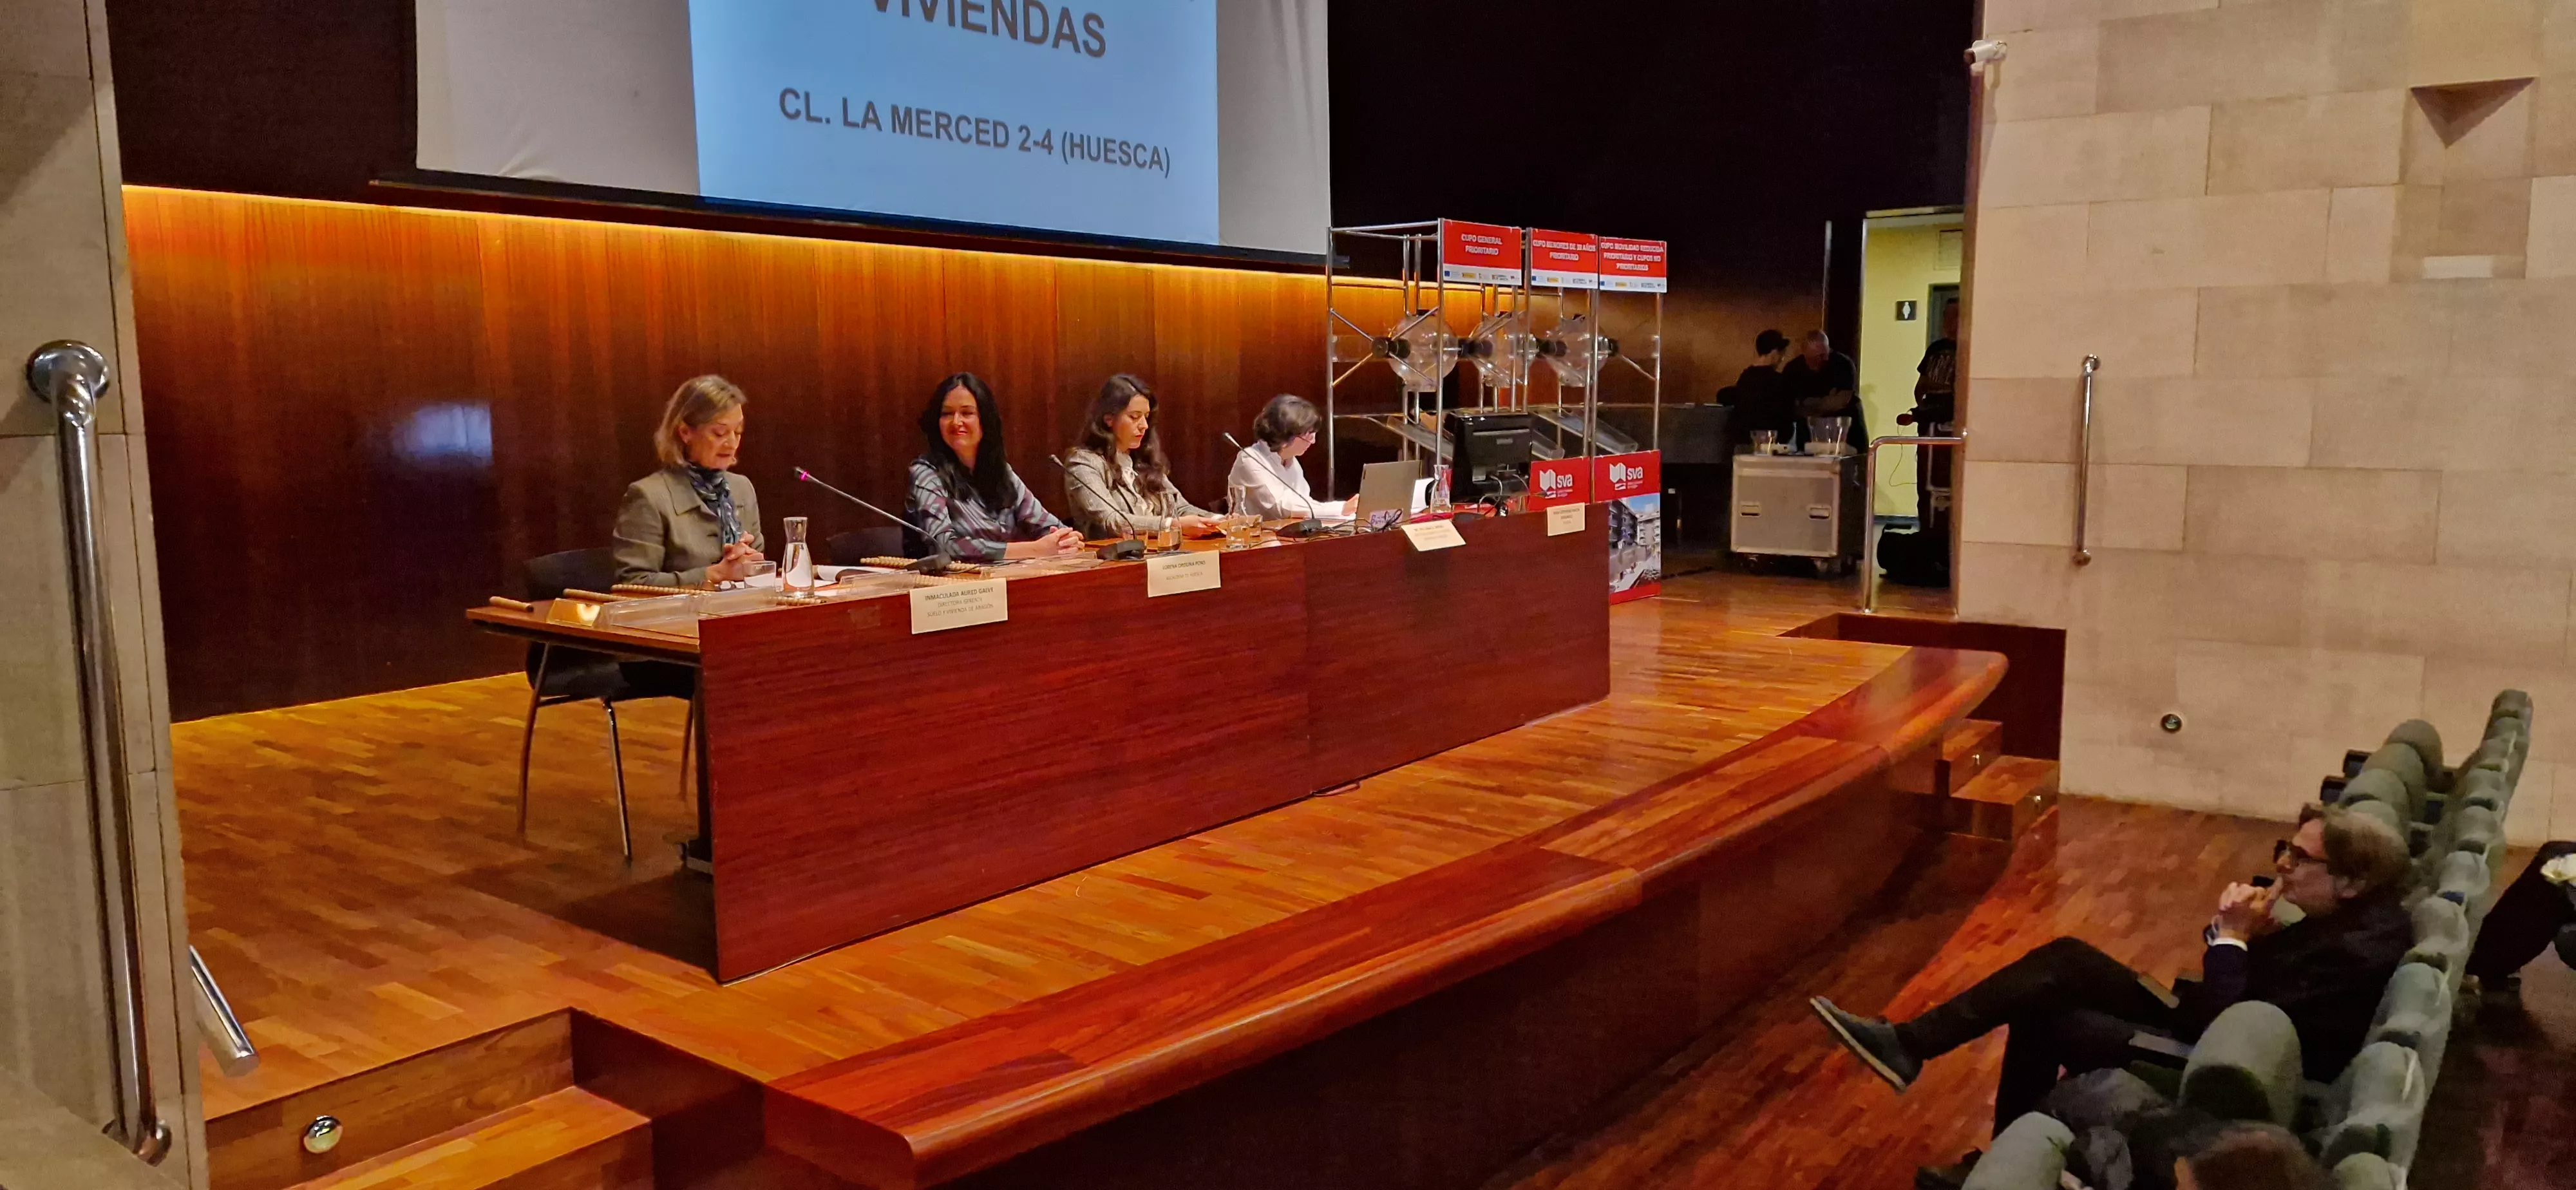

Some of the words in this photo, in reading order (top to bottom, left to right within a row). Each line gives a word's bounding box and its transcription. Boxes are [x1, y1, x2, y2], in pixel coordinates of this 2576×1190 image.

[779, 87, 830, 124] CL.
[842, 97, 882, 131] LA
[891, 103, 1009, 148] MERCED
[1018, 125, 1054, 155] 2-4
[1062, 131, 1170, 179] (HUESCA)
[1461, 234, 1477, 242] CUPO
[1477, 235, 1502, 245] GENERAL
[1465, 245, 1499, 255] PRIORITARIO
[1627, 466, 1643, 480] sva
[1557, 474, 1573, 488] sva
